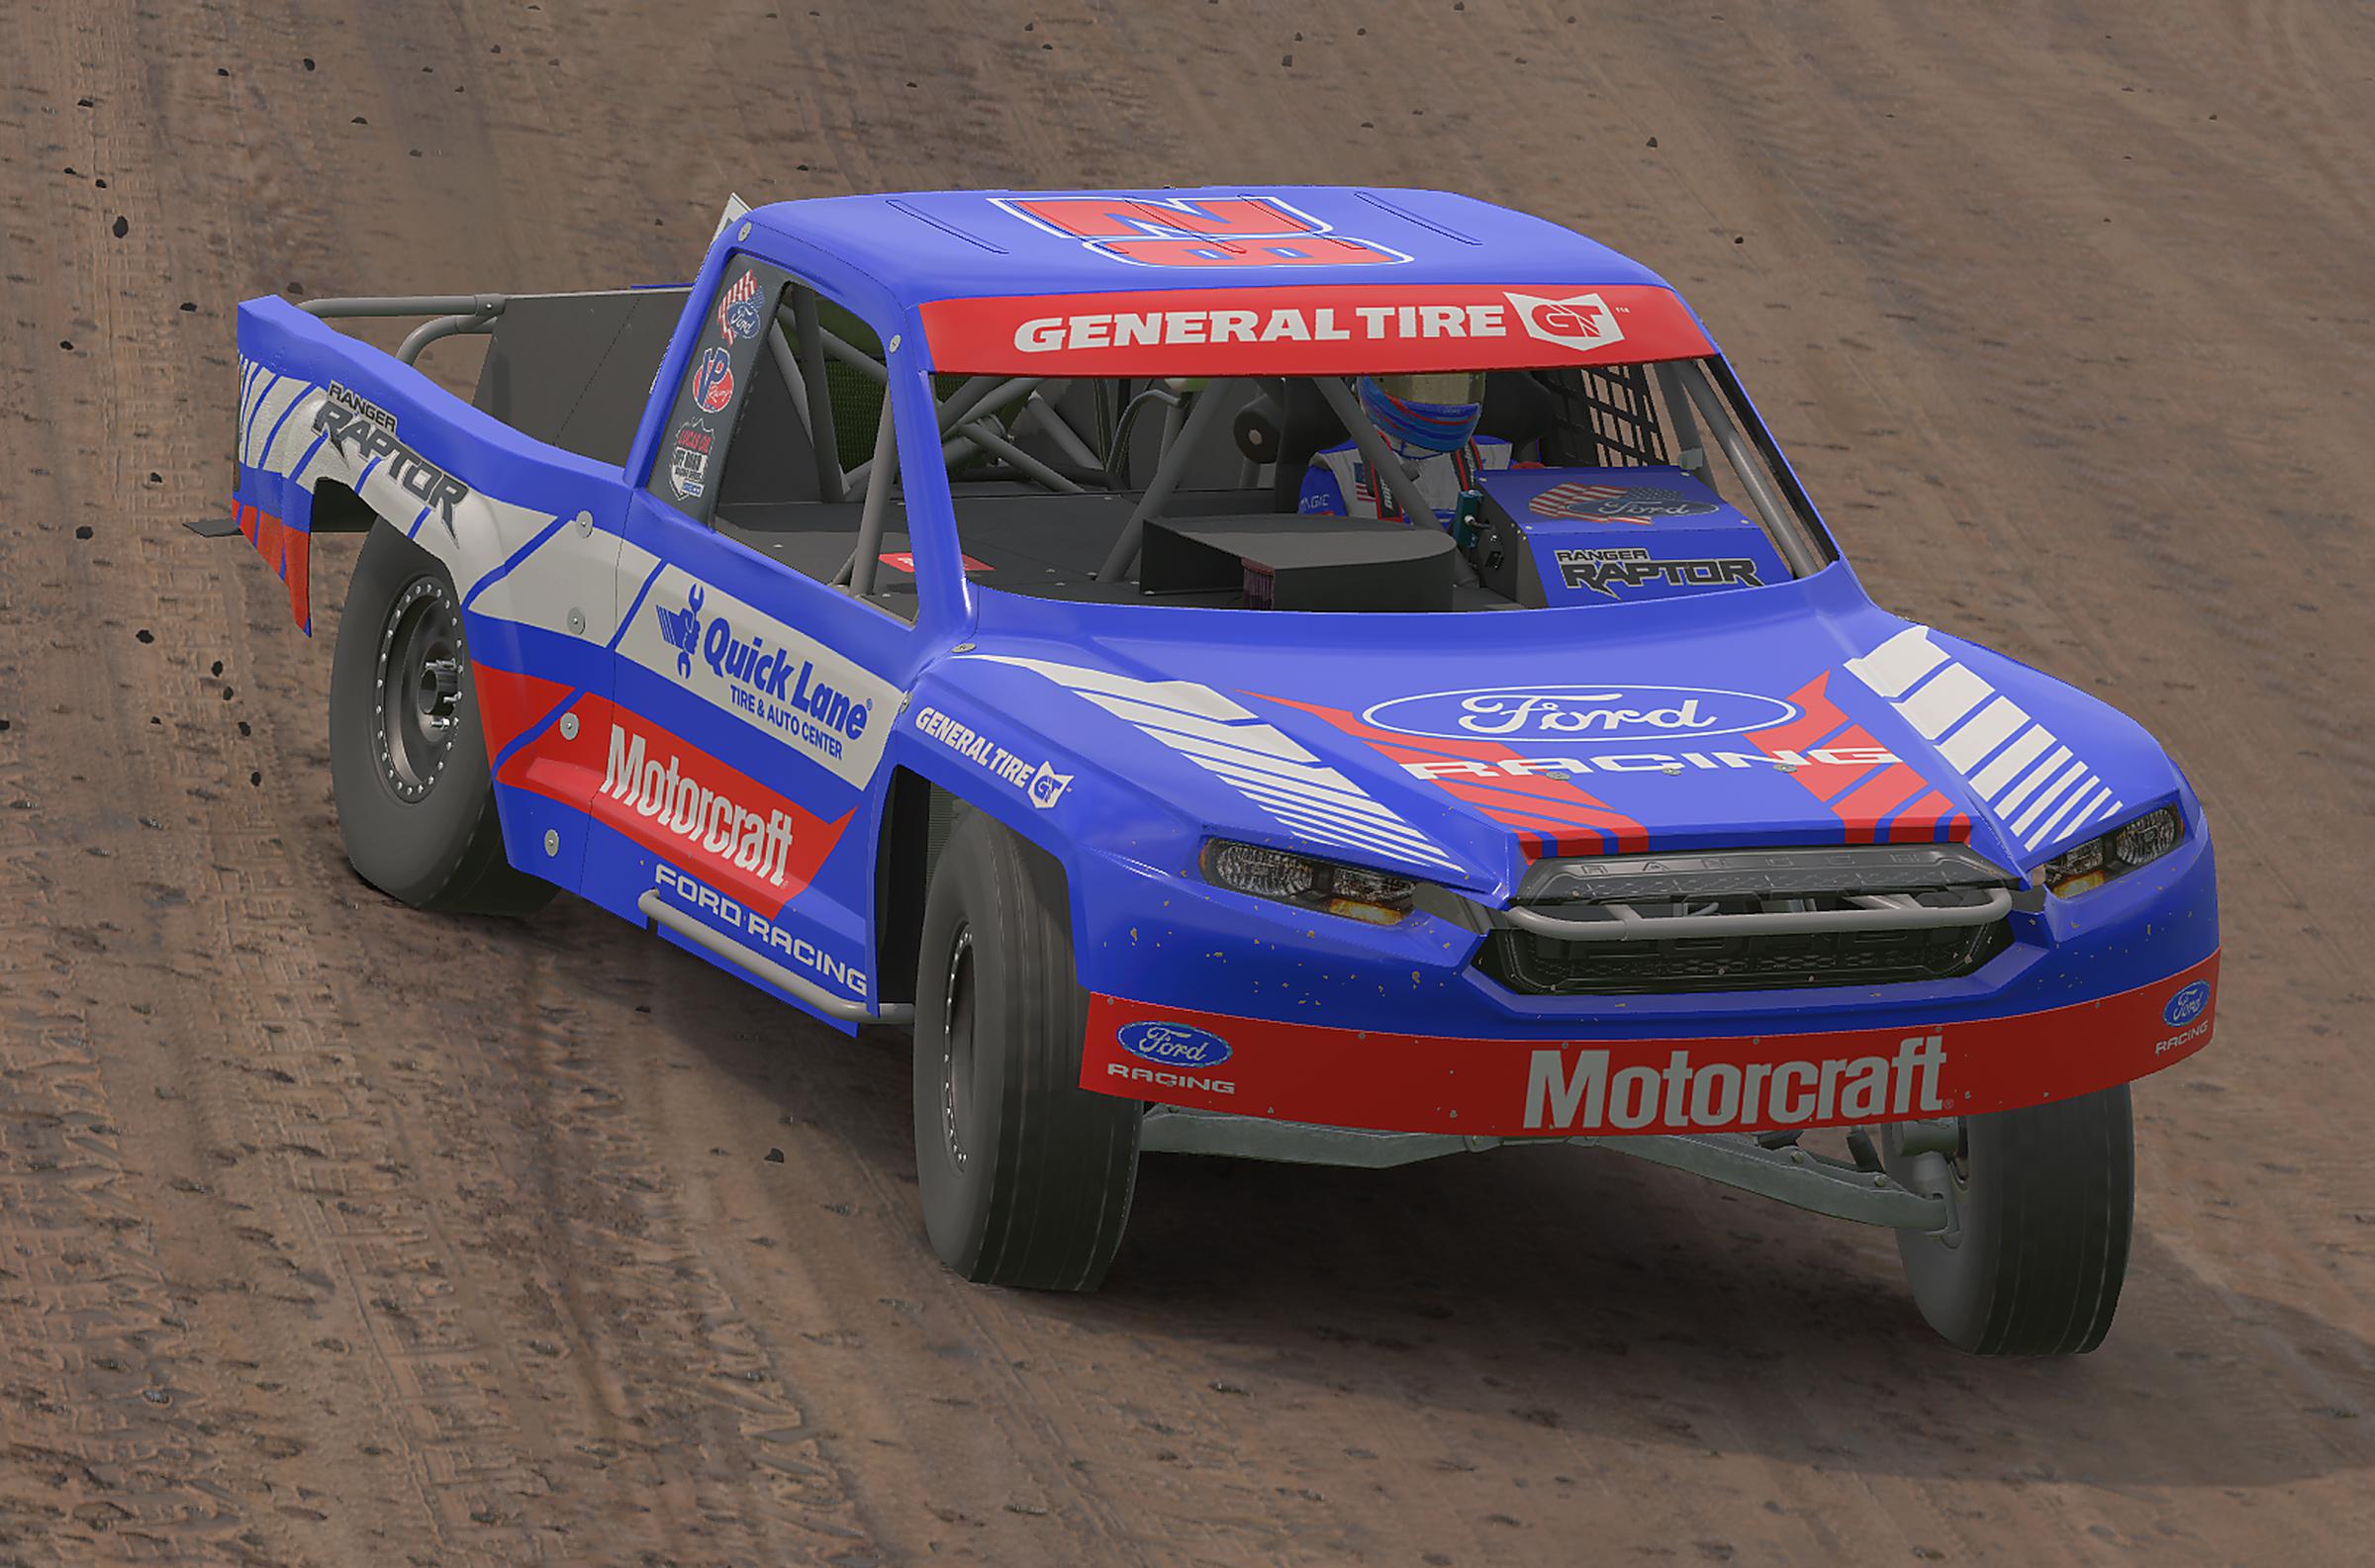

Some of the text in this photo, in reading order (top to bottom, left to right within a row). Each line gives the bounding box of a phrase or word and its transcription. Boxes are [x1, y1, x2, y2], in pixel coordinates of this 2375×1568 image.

[1013, 308, 1351, 353] GENERAL
[1355, 305, 1507, 339] TIRE
[329, 383, 396, 432] RANGER
[312, 400, 469, 550] RAPTOR
[1598, 500, 1690, 515] Ford
[1556, 549, 1649, 562] RANGER
[1560, 558, 1765, 600] RAPTOR
[704, 617, 868, 740] Quick Lane
[730, 684, 843, 760] TIRE & AUTO CENTER
[1458, 692, 1718, 734] Ford
[914, 706, 995, 767] GENERAL
[990, 747, 1035, 788] TIRE
[1398, 747, 1903, 781] RACING
[599, 723, 794, 886] Motorcraft
[655, 863, 868, 997] FORD RACING
[2172, 988, 2204, 1021] Ford
[1139, 1026, 1209, 1061] Ford
[2154, 1020, 2209, 1057] RACING
[1106, 1062, 1236, 1094] RACING
[1523, 1035, 1947, 1130] Motorcraft
